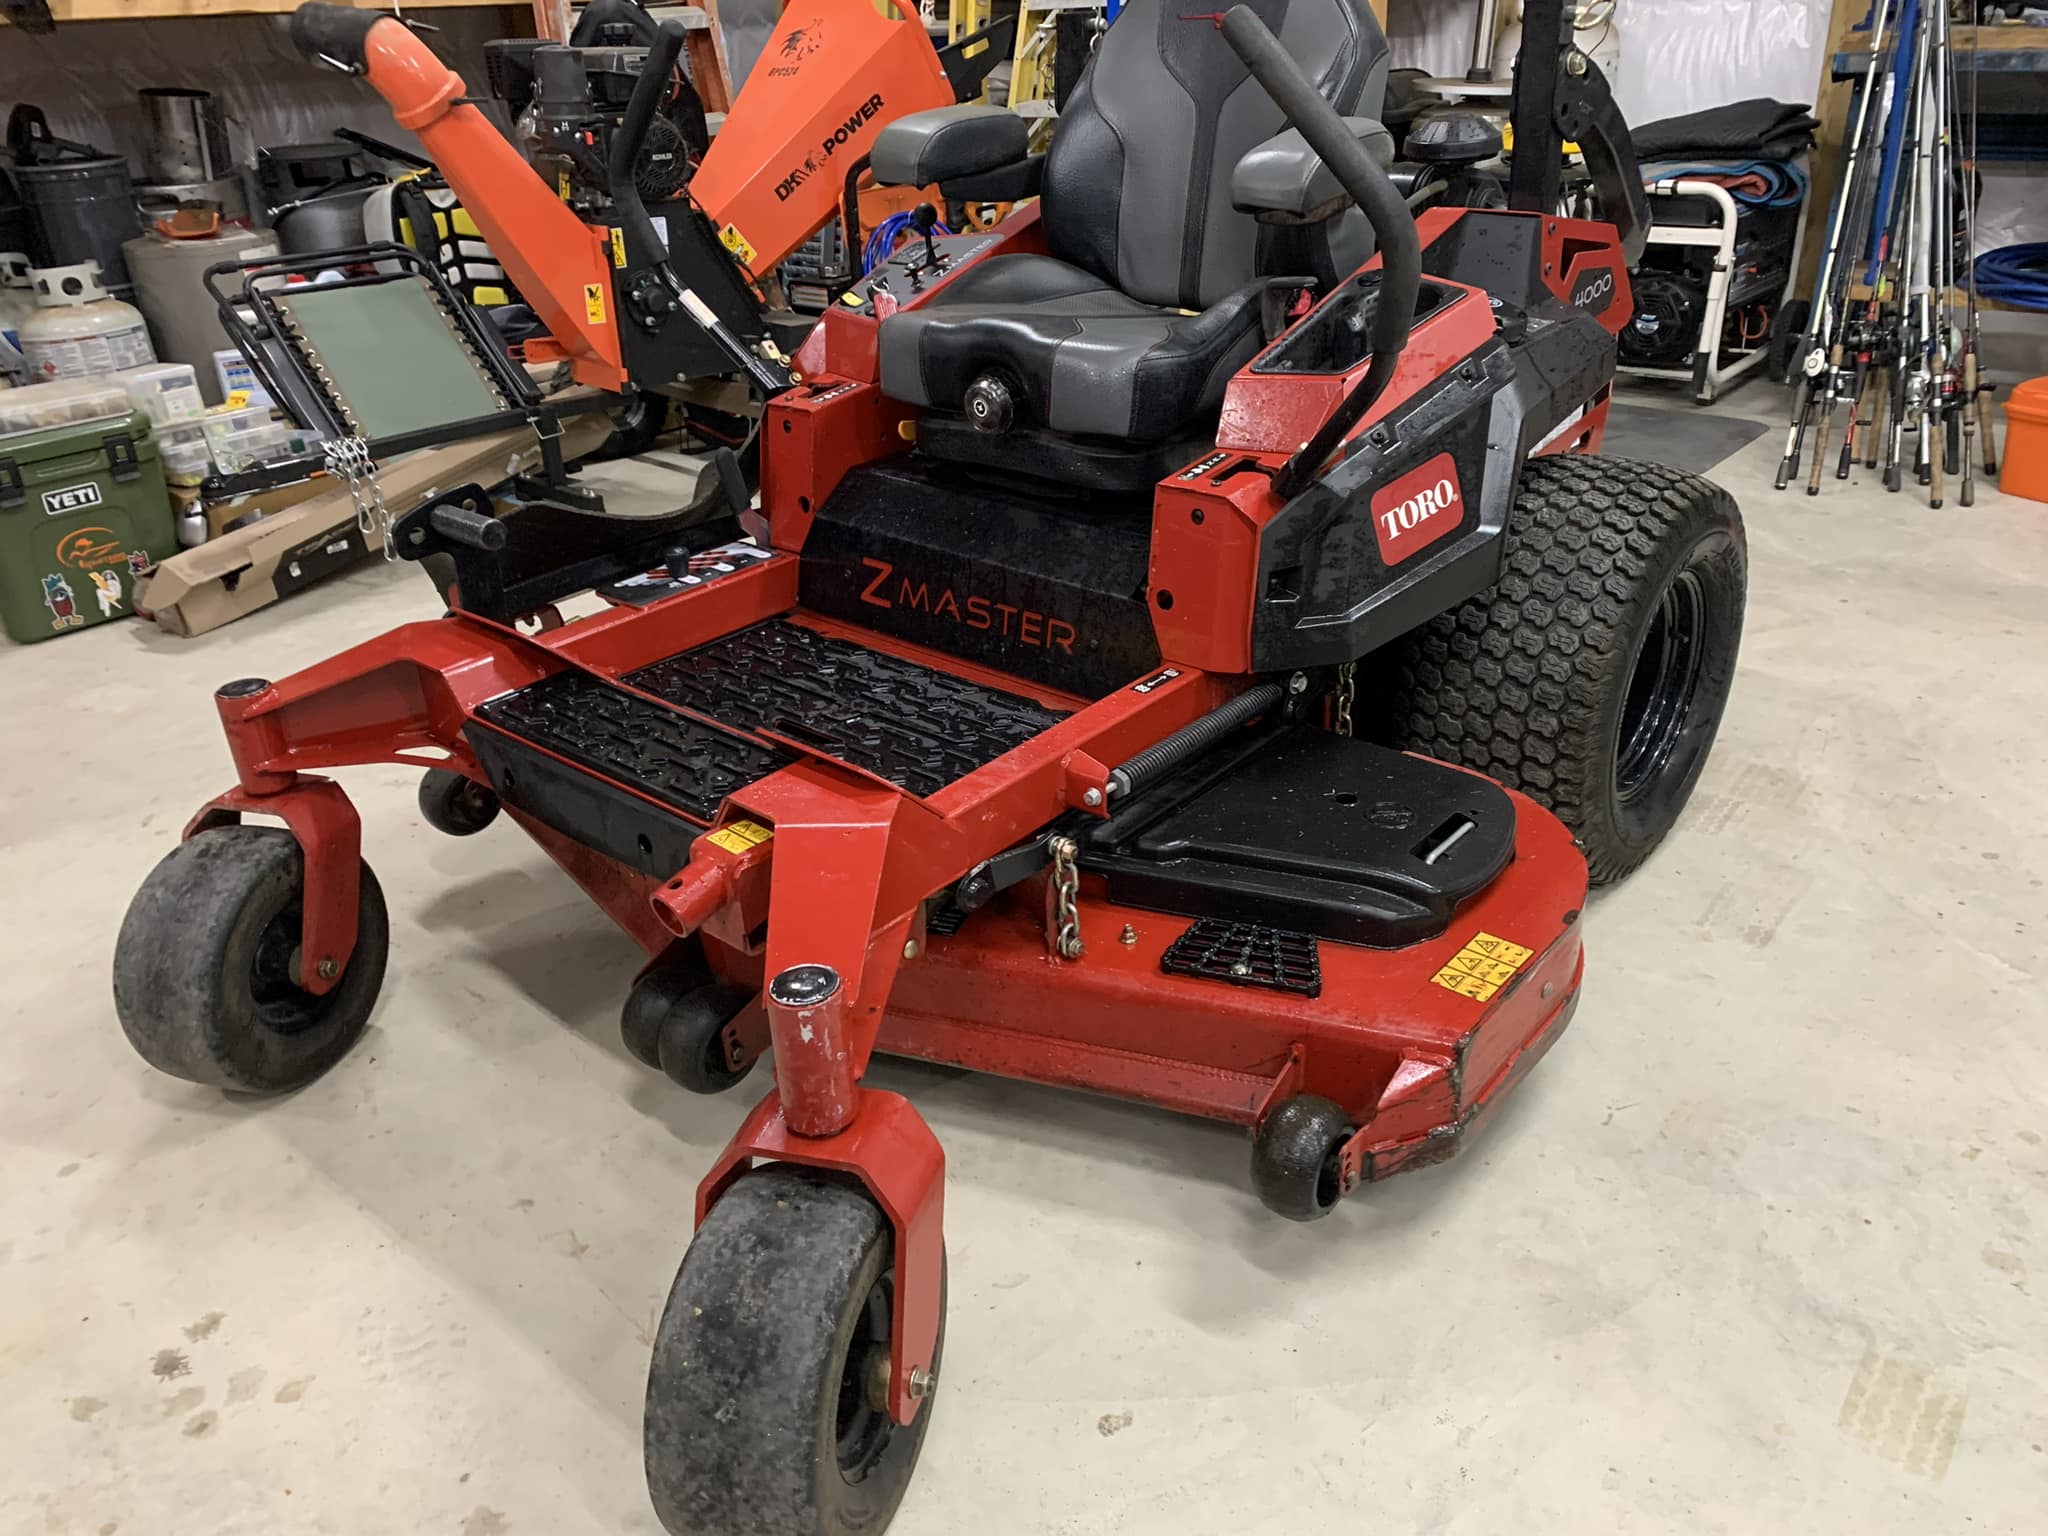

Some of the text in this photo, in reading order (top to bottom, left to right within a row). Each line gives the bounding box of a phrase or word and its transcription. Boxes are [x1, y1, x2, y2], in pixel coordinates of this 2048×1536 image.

[822, 93, 885, 156] POWER
[1574, 273, 1612, 308] 4000
[46, 487, 97, 510] YETI
[860, 556, 1076, 655] Z MASTER
